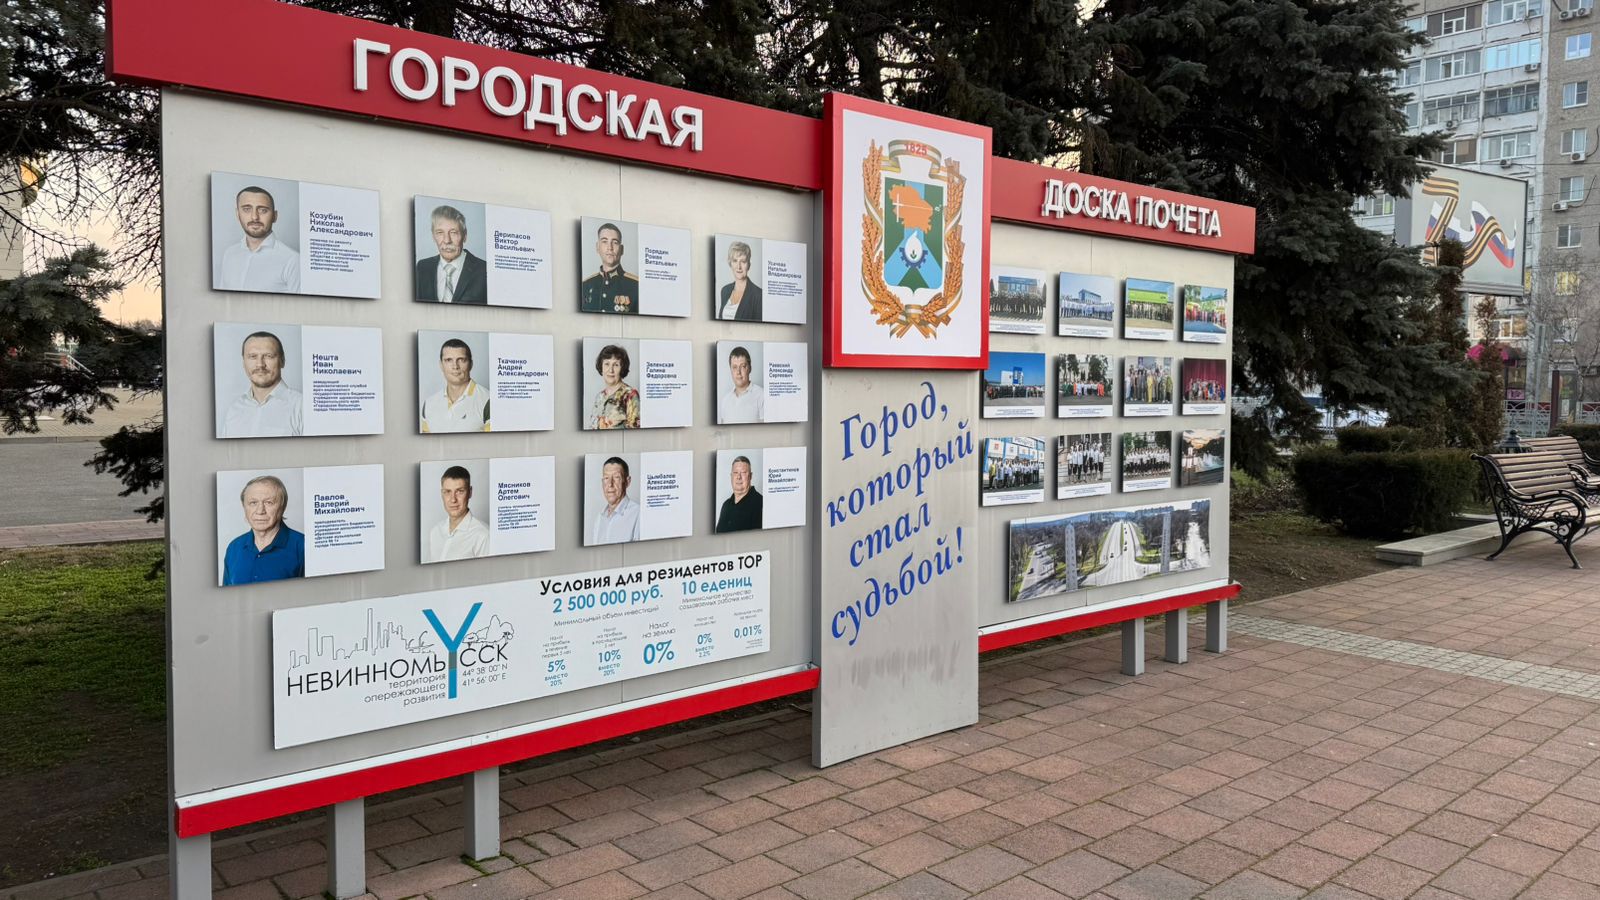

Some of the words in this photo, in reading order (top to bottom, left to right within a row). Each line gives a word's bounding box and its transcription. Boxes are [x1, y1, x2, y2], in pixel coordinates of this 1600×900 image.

[354, 38, 703, 151] ГОРОДСКАЯ
[904, 143, 928, 156] 1825
[310, 211, 343, 220] Козубин
[1042, 179, 1131, 223] ДОСКА
[1136, 196, 1222, 237] ПОЧЕТА
[309, 218, 344, 228] Николай
[310, 225, 373, 237] Александрович
[495, 237, 518, 245] Виктор
[495, 243, 535, 252] Васильевич
[840, 381, 948, 461] Город,
[826, 419, 974, 527] который
[314, 500, 350, 509] Валерий
[314, 507, 365, 515] Михайлович
[850, 502, 931, 568] стал
[540, 575, 611, 595] Условия
[616, 572, 643, 587] для
[648, 560, 734, 584] резидентов
[738, 554, 762, 570] ТОР
[682, 580, 697, 595] 10
[700, 576, 752, 593] едениц
[831, 526, 963, 646] судьбой!
[553, 598, 562, 613] 2
[567, 593, 595, 611] 500
[600, 589, 626, 606] 000
[631, 584, 663, 605] руб.
[697, 633, 713, 645] 0%
[734, 624, 763, 639] 0,01%
[598, 648, 622, 663] 10%
[643, 639, 675, 665] 0%
[547, 659, 566, 673] 5%
[389, 673, 446, 690] территория
[544, 673, 569, 681] вместо
[364, 682, 446, 703] опережающего
[403, 692, 446, 708] развития
